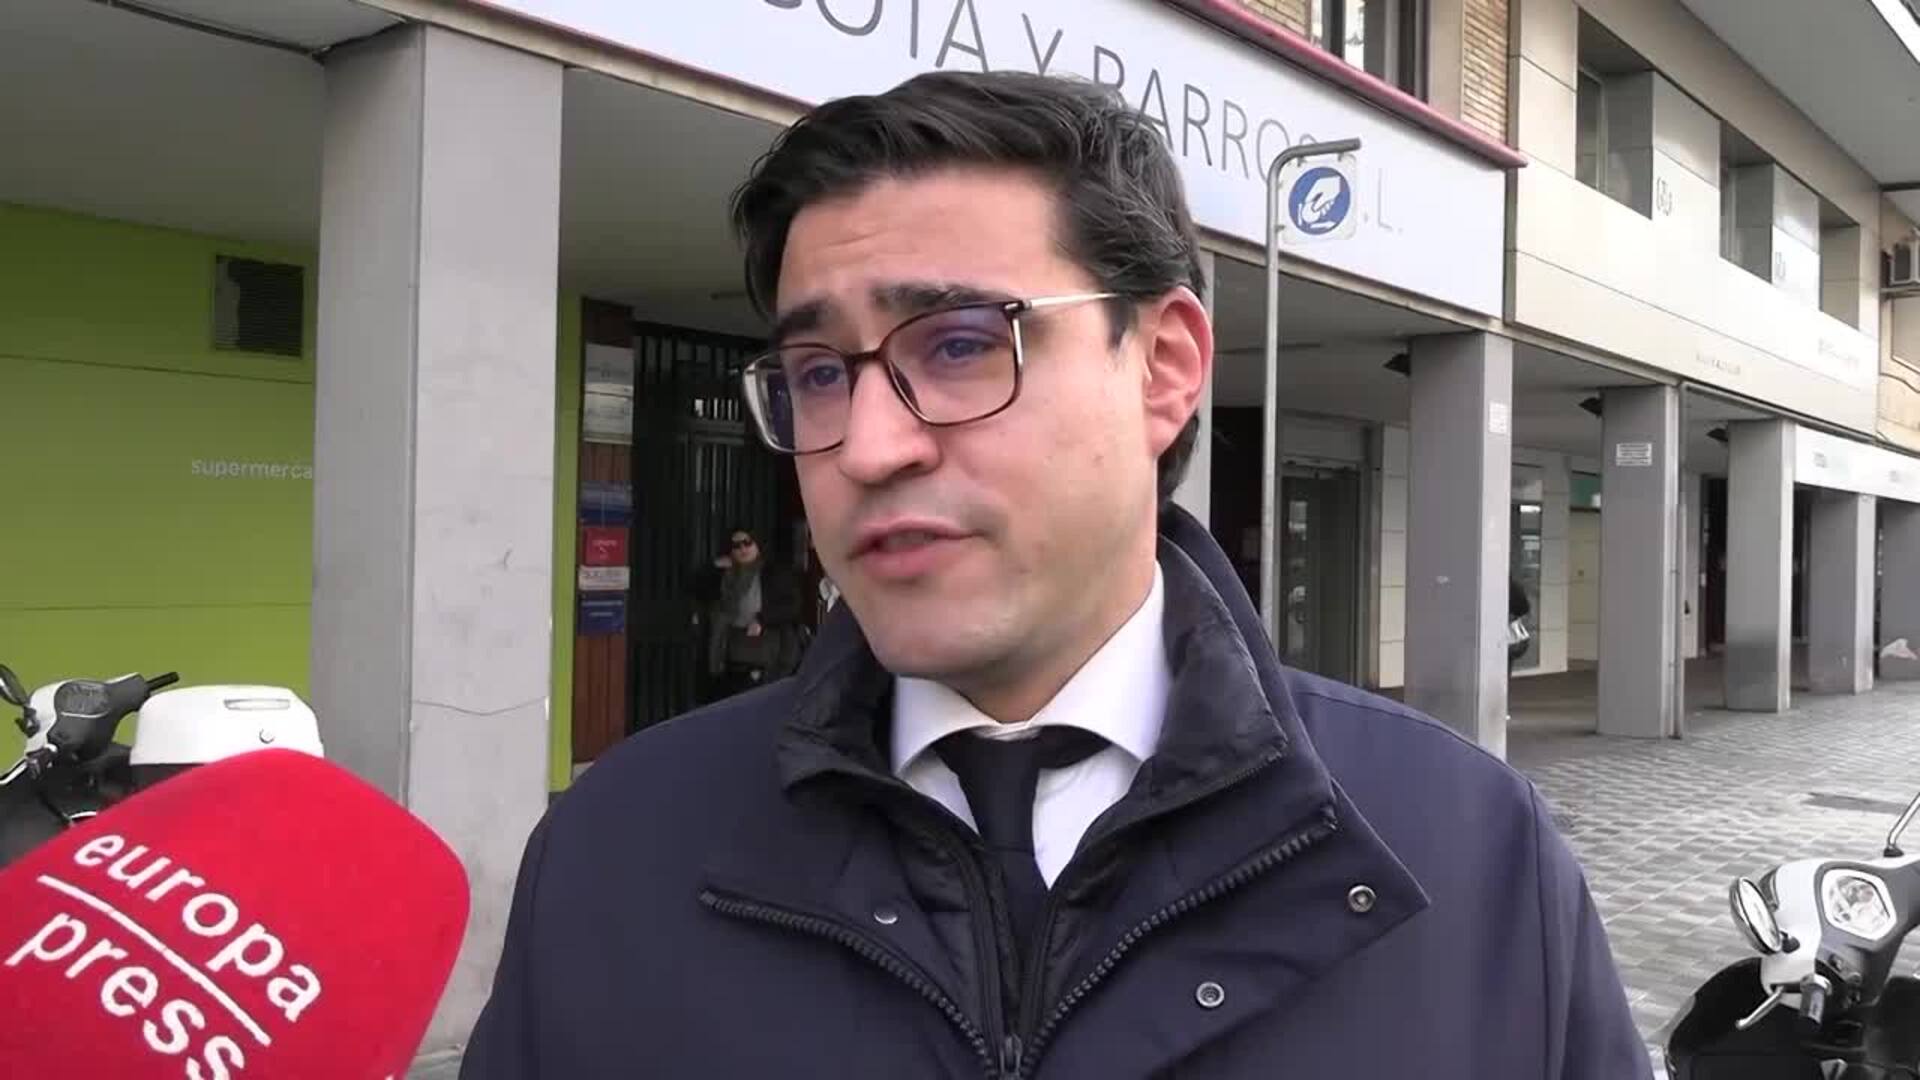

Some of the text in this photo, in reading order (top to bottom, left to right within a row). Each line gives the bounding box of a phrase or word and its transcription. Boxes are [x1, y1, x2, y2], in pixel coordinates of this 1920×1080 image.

[1093, 45, 1318, 184] BARRO
[4, 912, 246, 1080] press
[73, 833, 322, 1022] europa
